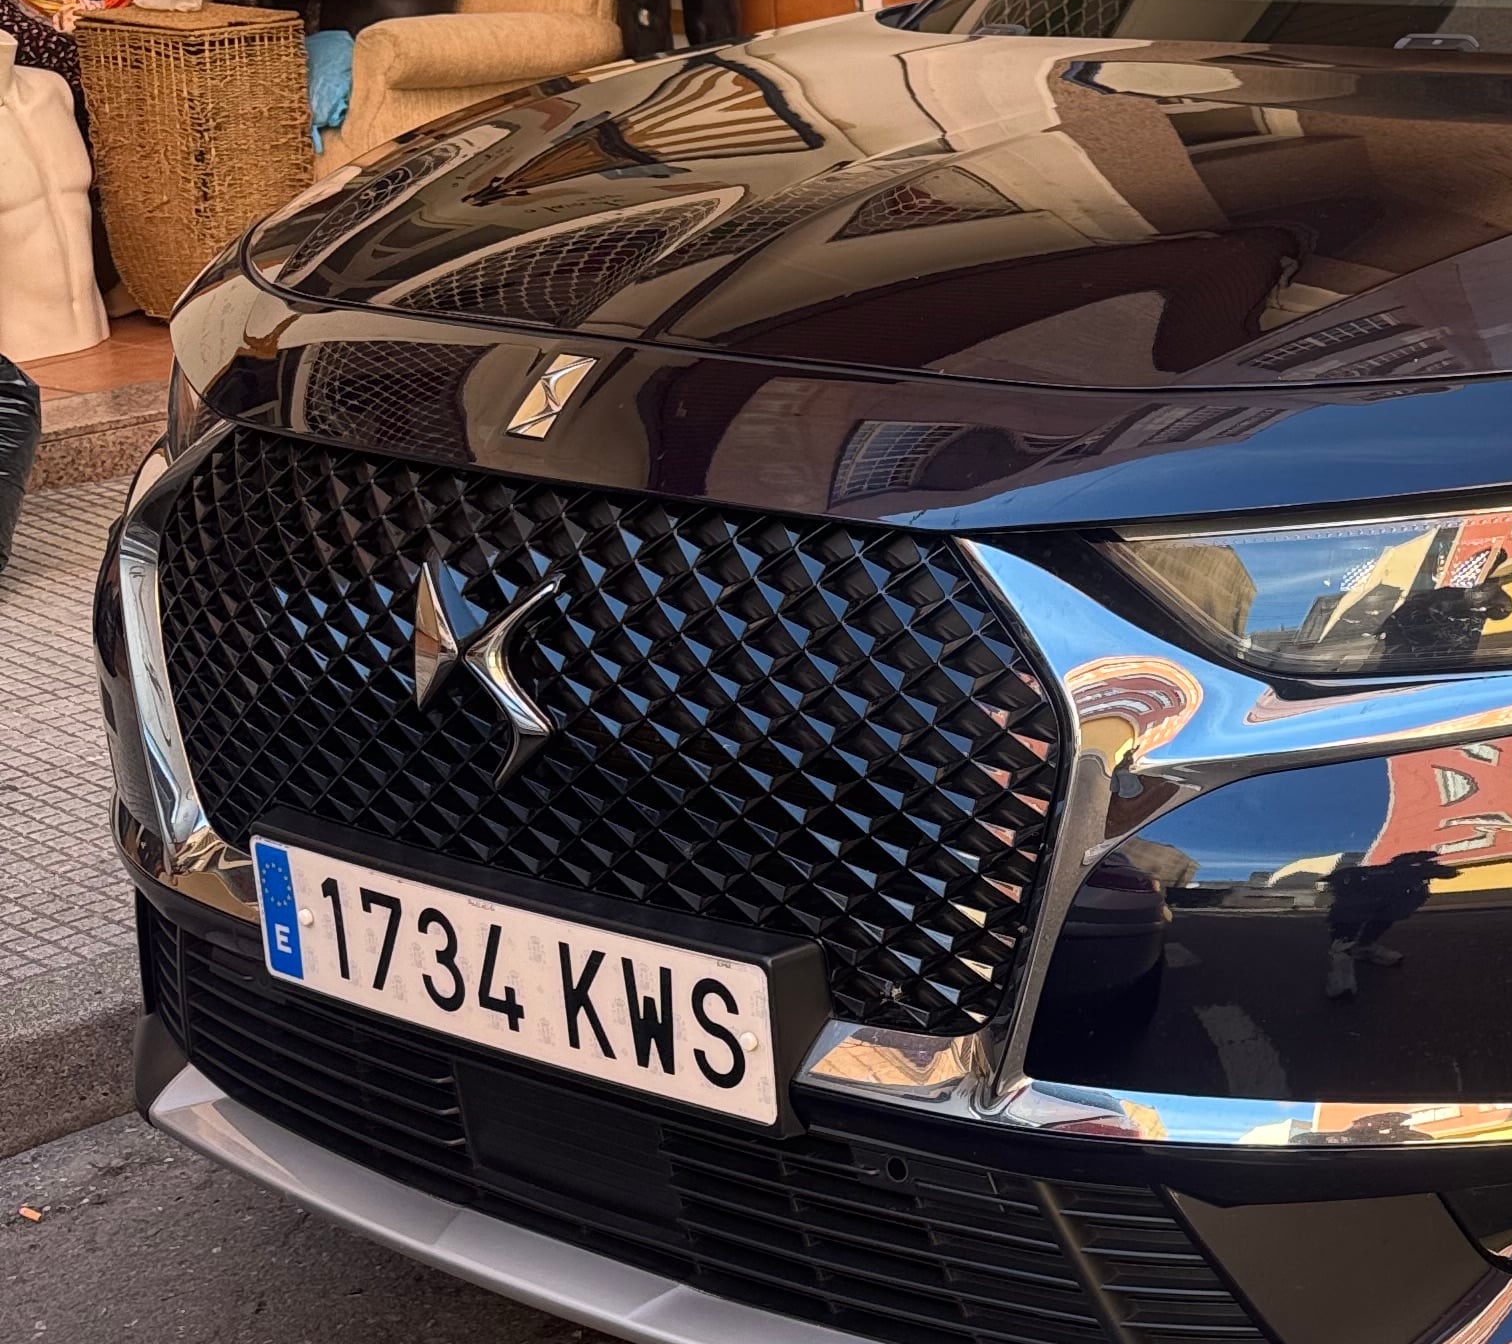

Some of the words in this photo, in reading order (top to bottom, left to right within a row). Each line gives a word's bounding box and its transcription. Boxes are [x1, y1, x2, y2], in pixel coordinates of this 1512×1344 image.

[275, 923, 292, 954] E
[321, 877, 525, 1032] 1734
[558, 942, 746, 1089] KWS
